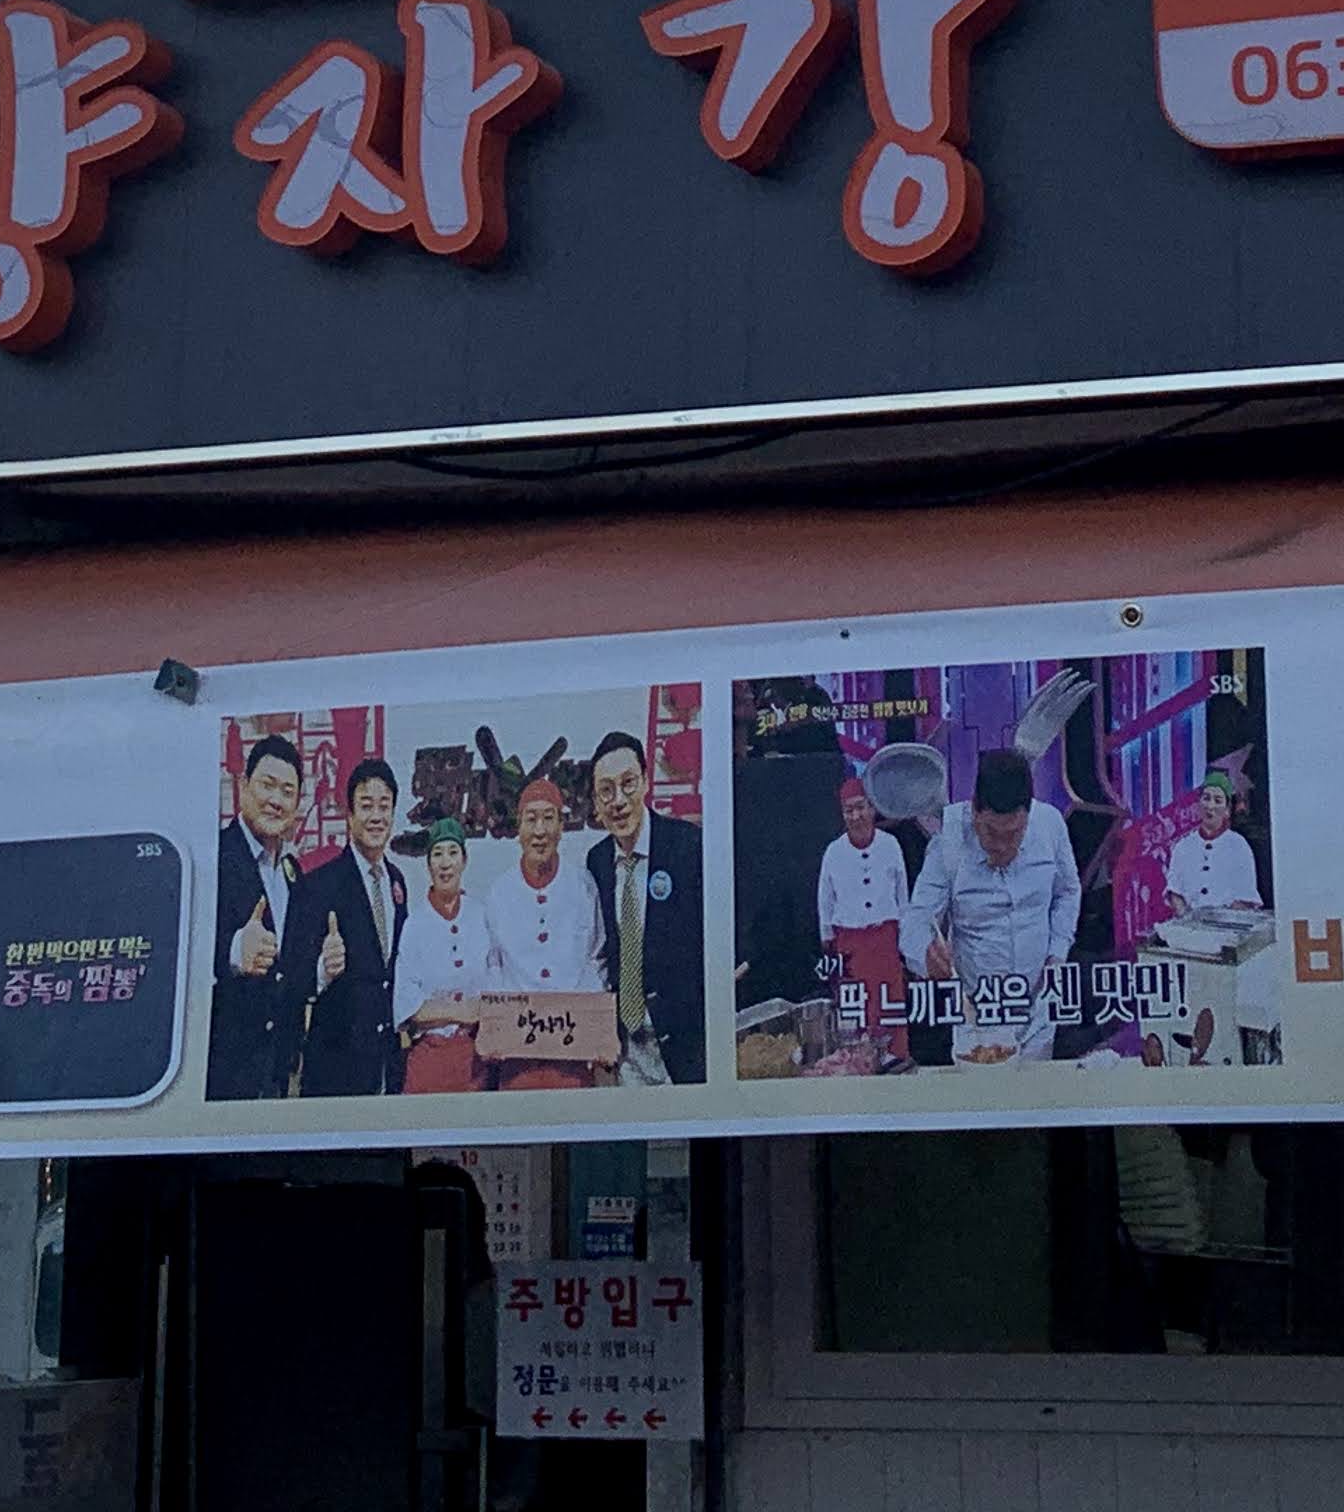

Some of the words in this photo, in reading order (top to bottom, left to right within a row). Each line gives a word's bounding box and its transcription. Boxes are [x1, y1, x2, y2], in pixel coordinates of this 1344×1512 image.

[1209, 674, 1243, 694] SBS
[136, 842, 162, 858] SBS
[3, 969, 73, 1006] 중독의
[839, 980, 868, 1027] 딱
[880, 977, 965, 1026] 느끼고
[974, 972, 1030, 1025] 싶은
[1040, 962, 1083, 1024] 센
[518, 1010, 576, 1046] 양자강
[505, 1275, 694, 1329] 주방입구
[513, 1364, 570, 1396] 정문을
